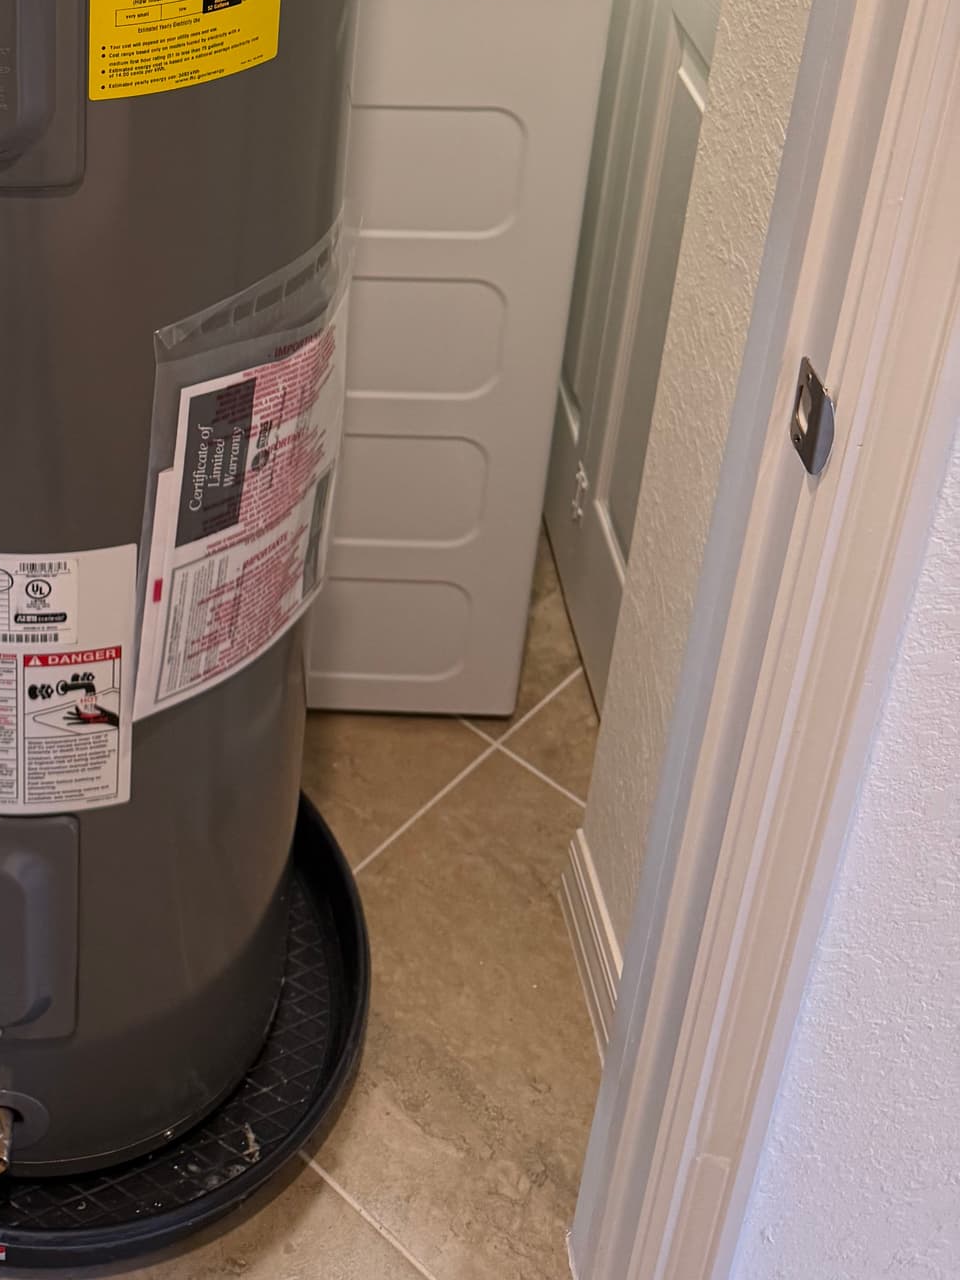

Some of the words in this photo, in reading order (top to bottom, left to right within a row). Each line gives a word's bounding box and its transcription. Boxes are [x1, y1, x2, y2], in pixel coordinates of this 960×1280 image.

[198, 424, 214, 442] of
[223, 426, 245, 488] Warranty
[189, 442, 209, 512] Certificate
[208, 438, 226, 487] Limited
[47, 649, 116, 665] DANGER
